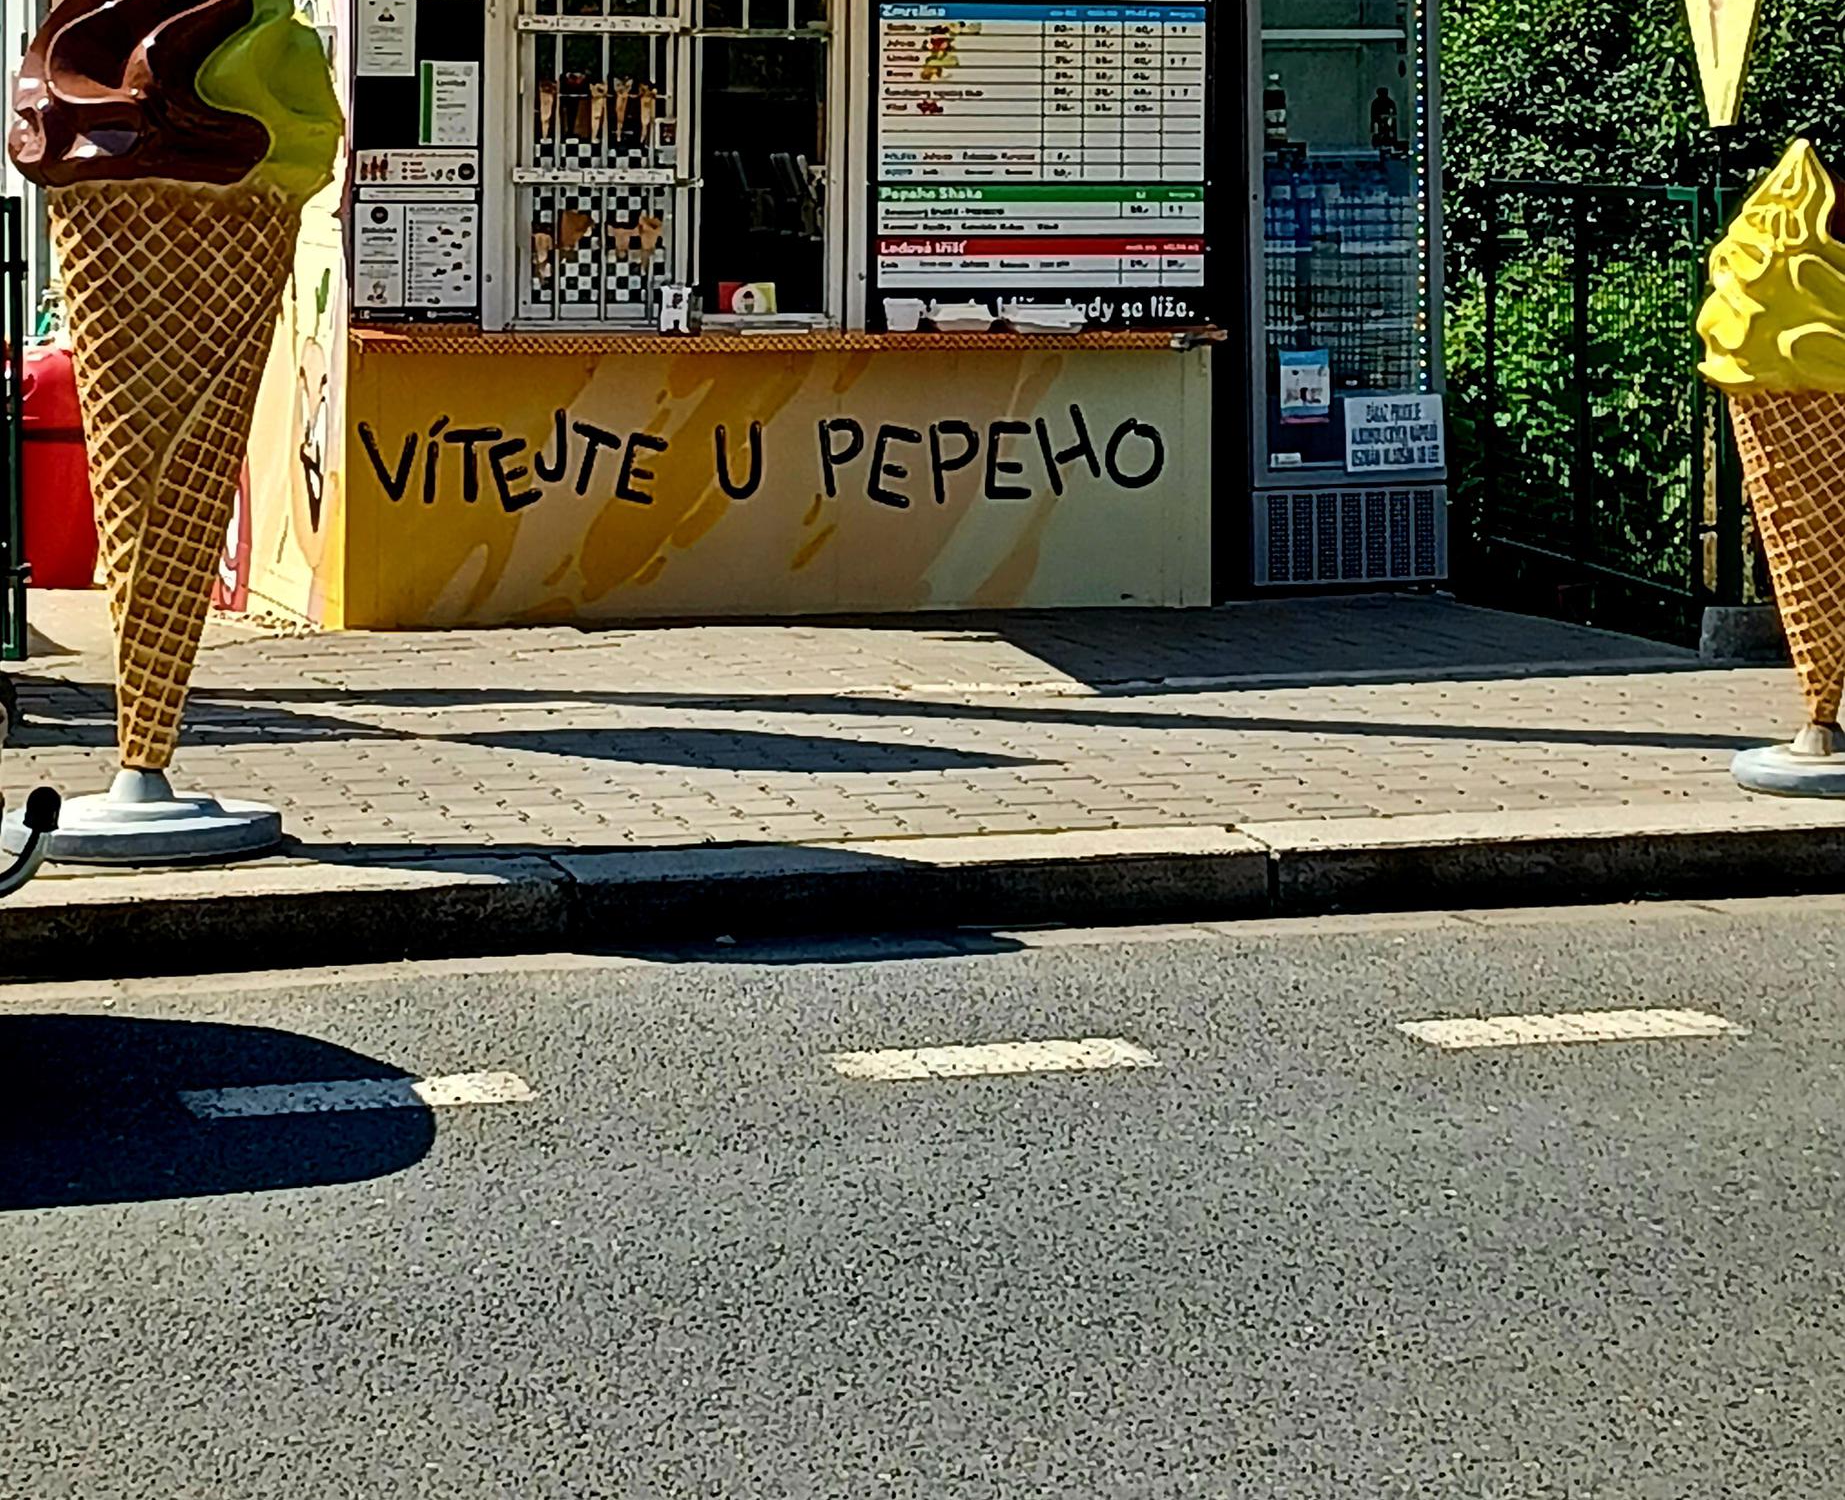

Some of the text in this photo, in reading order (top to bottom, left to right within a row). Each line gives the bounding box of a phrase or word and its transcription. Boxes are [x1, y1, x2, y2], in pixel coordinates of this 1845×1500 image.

[939, 187, 983, 200] Shake
[881, 241, 932, 254] Ledová
[1121, 302, 1144, 318] se
[358, 404, 1165, 512] VÍTEJTE U PEPEHO
